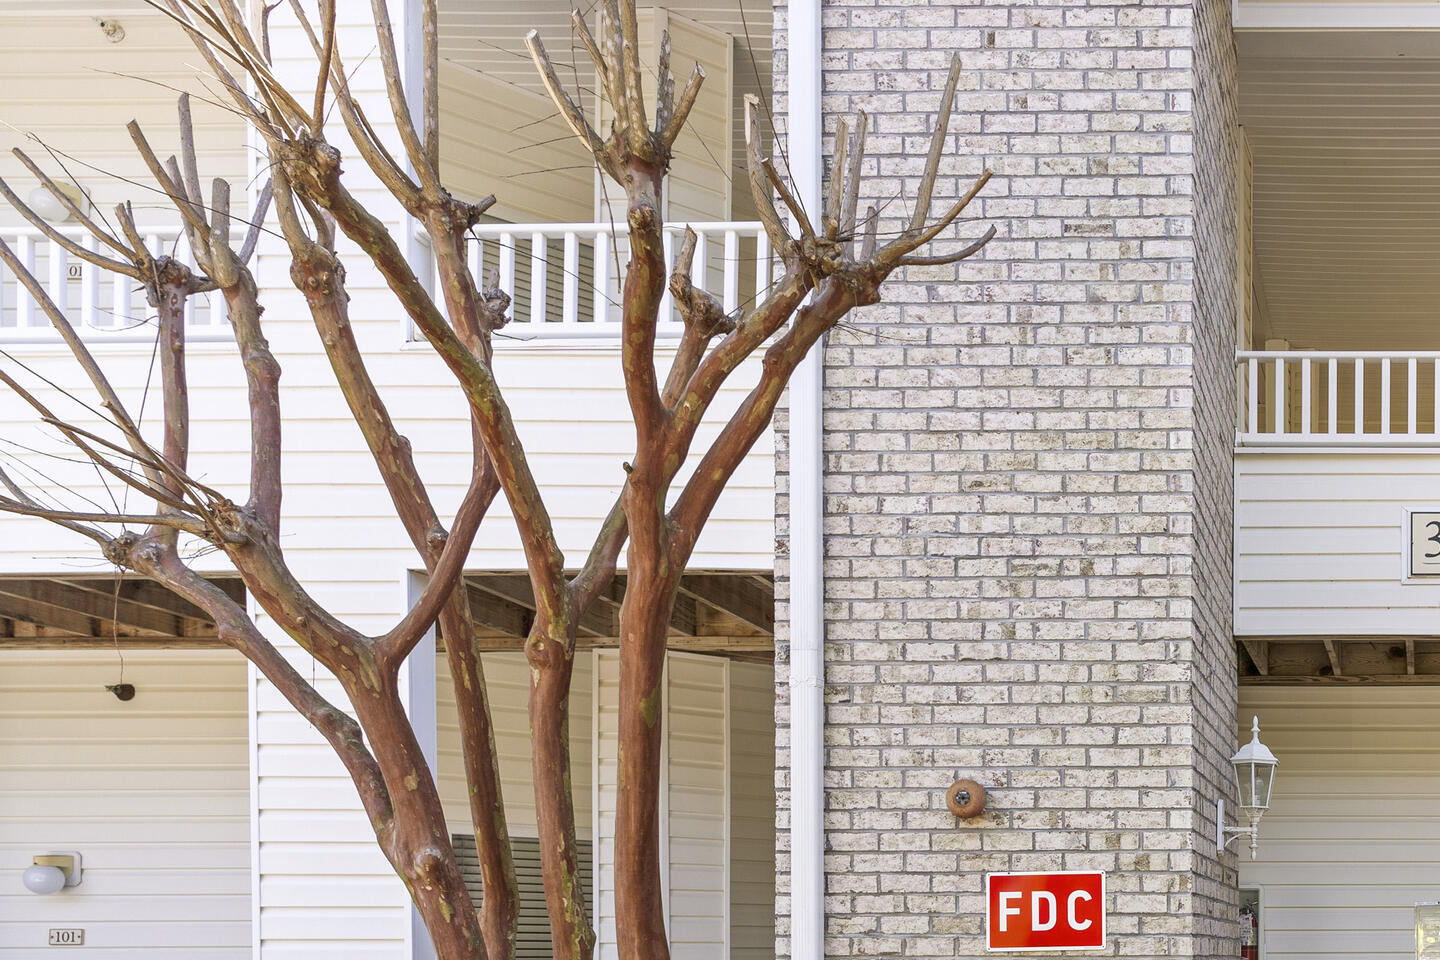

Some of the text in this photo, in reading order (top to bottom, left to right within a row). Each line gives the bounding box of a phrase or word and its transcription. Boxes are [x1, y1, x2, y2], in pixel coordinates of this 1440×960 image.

[66, 265, 82, 277] 01
[999, 889, 1093, 932] FDC
[55, 931, 77, 943] 101
